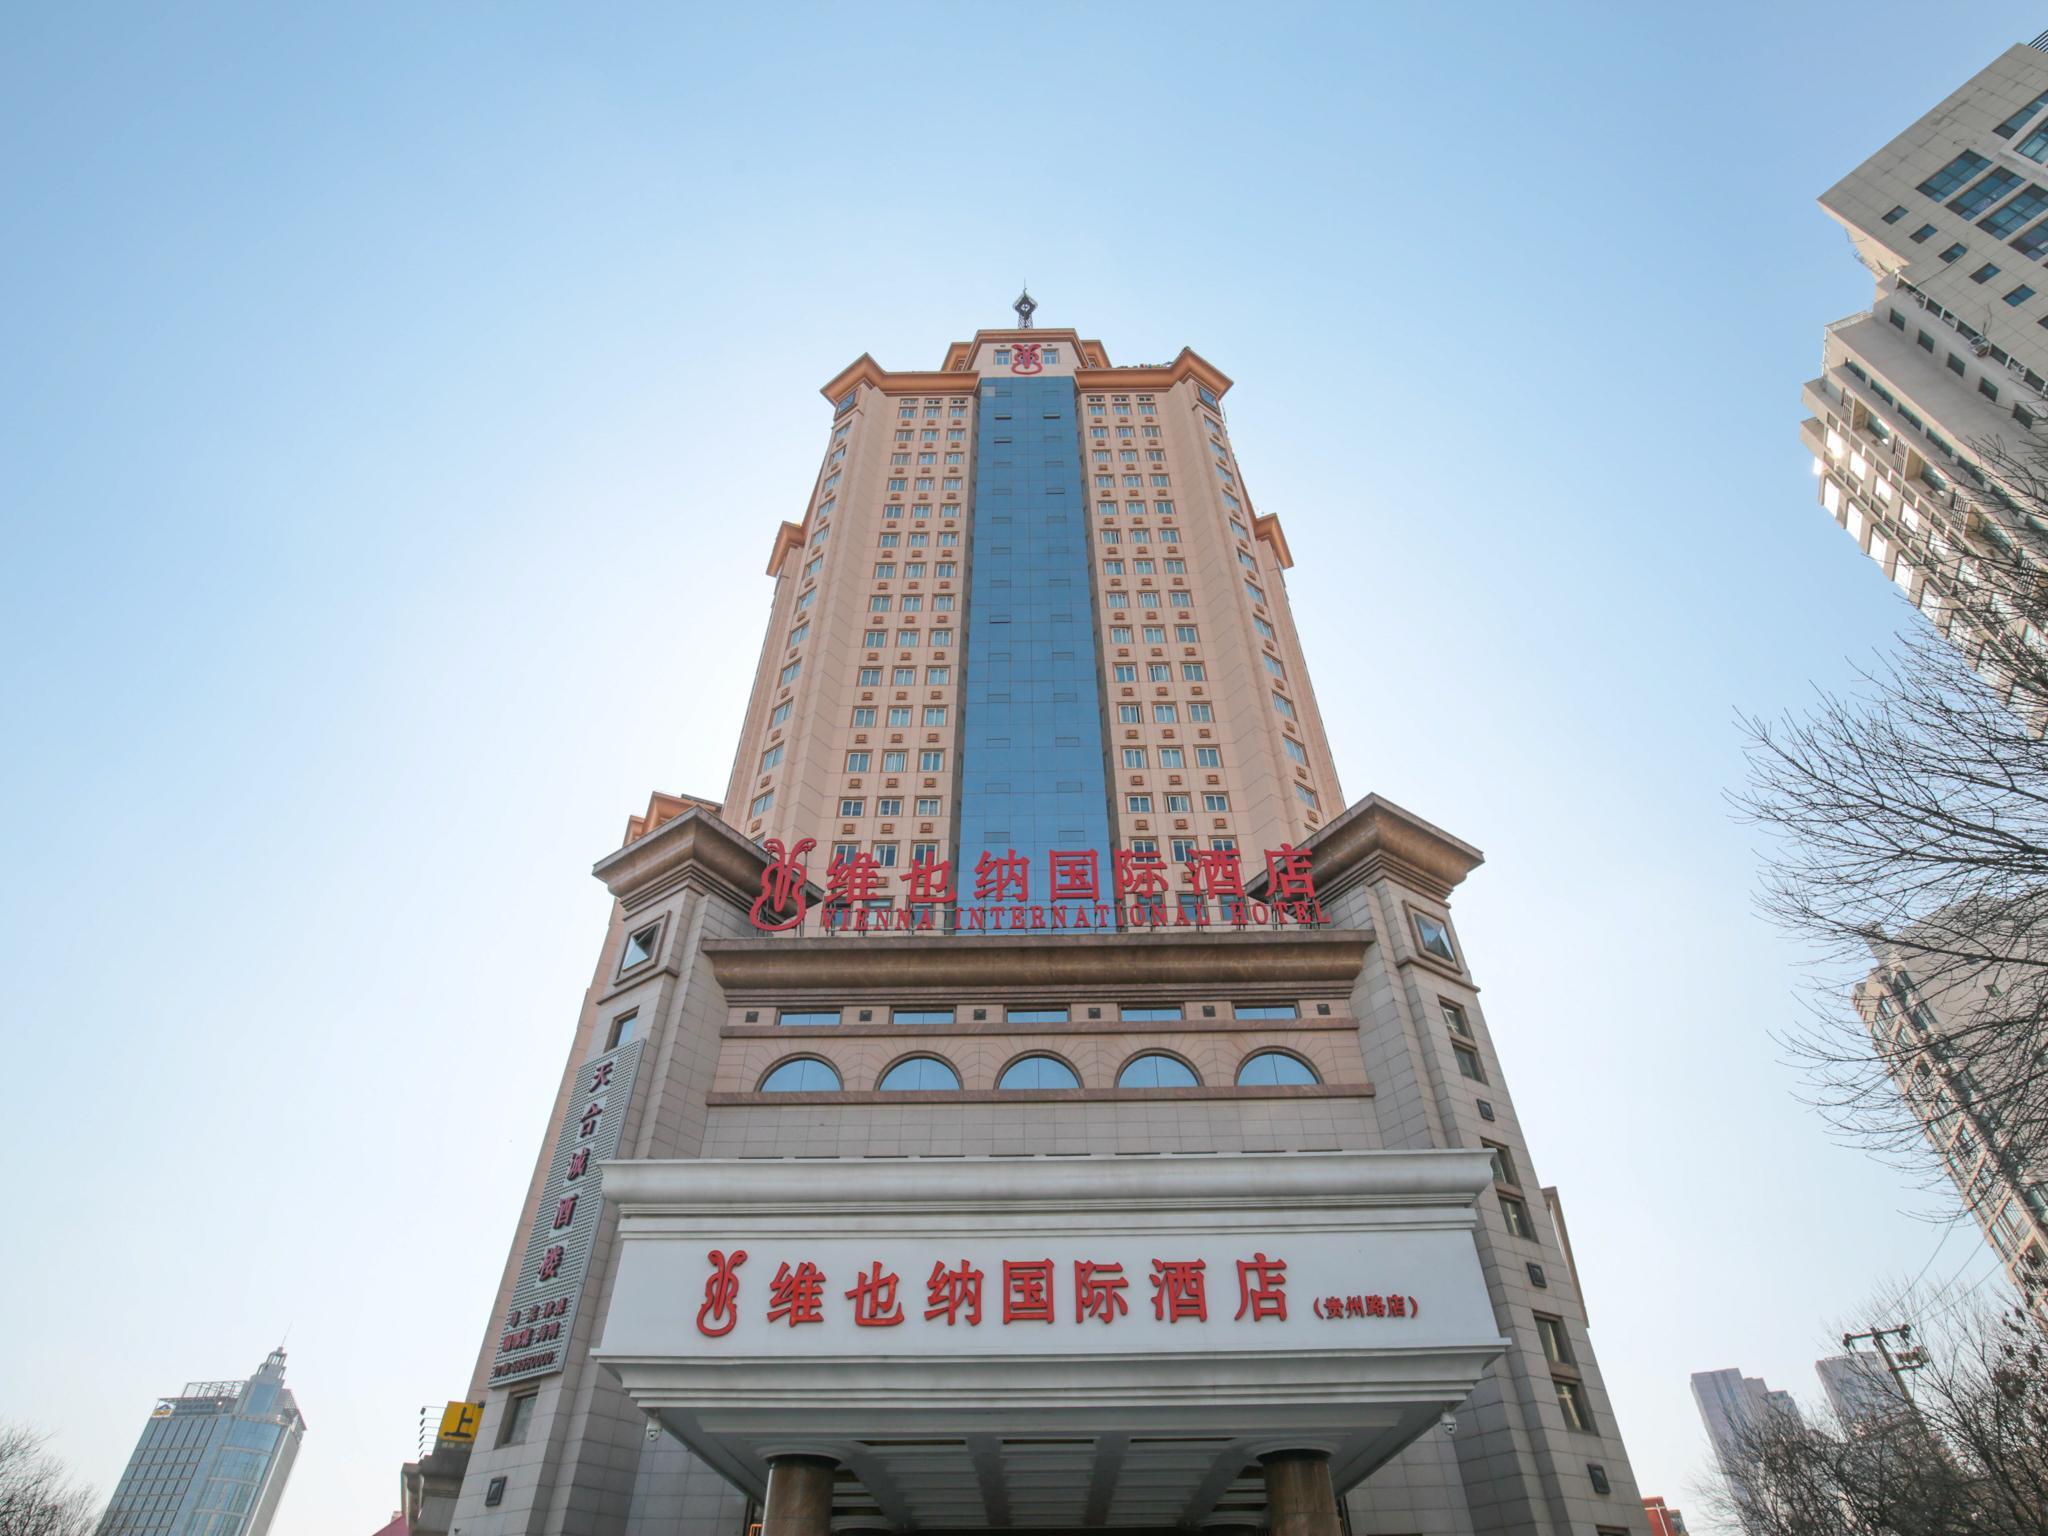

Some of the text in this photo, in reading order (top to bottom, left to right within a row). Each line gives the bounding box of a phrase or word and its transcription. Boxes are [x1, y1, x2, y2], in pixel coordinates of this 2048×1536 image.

[823, 843, 1316, 904] 维也纳国际酒店
[822, 898, 1331, 931] VIENNA INTERNATIONAL HOTEL
[766, 1252, 1288, 1327] 维也纳国际酒店
